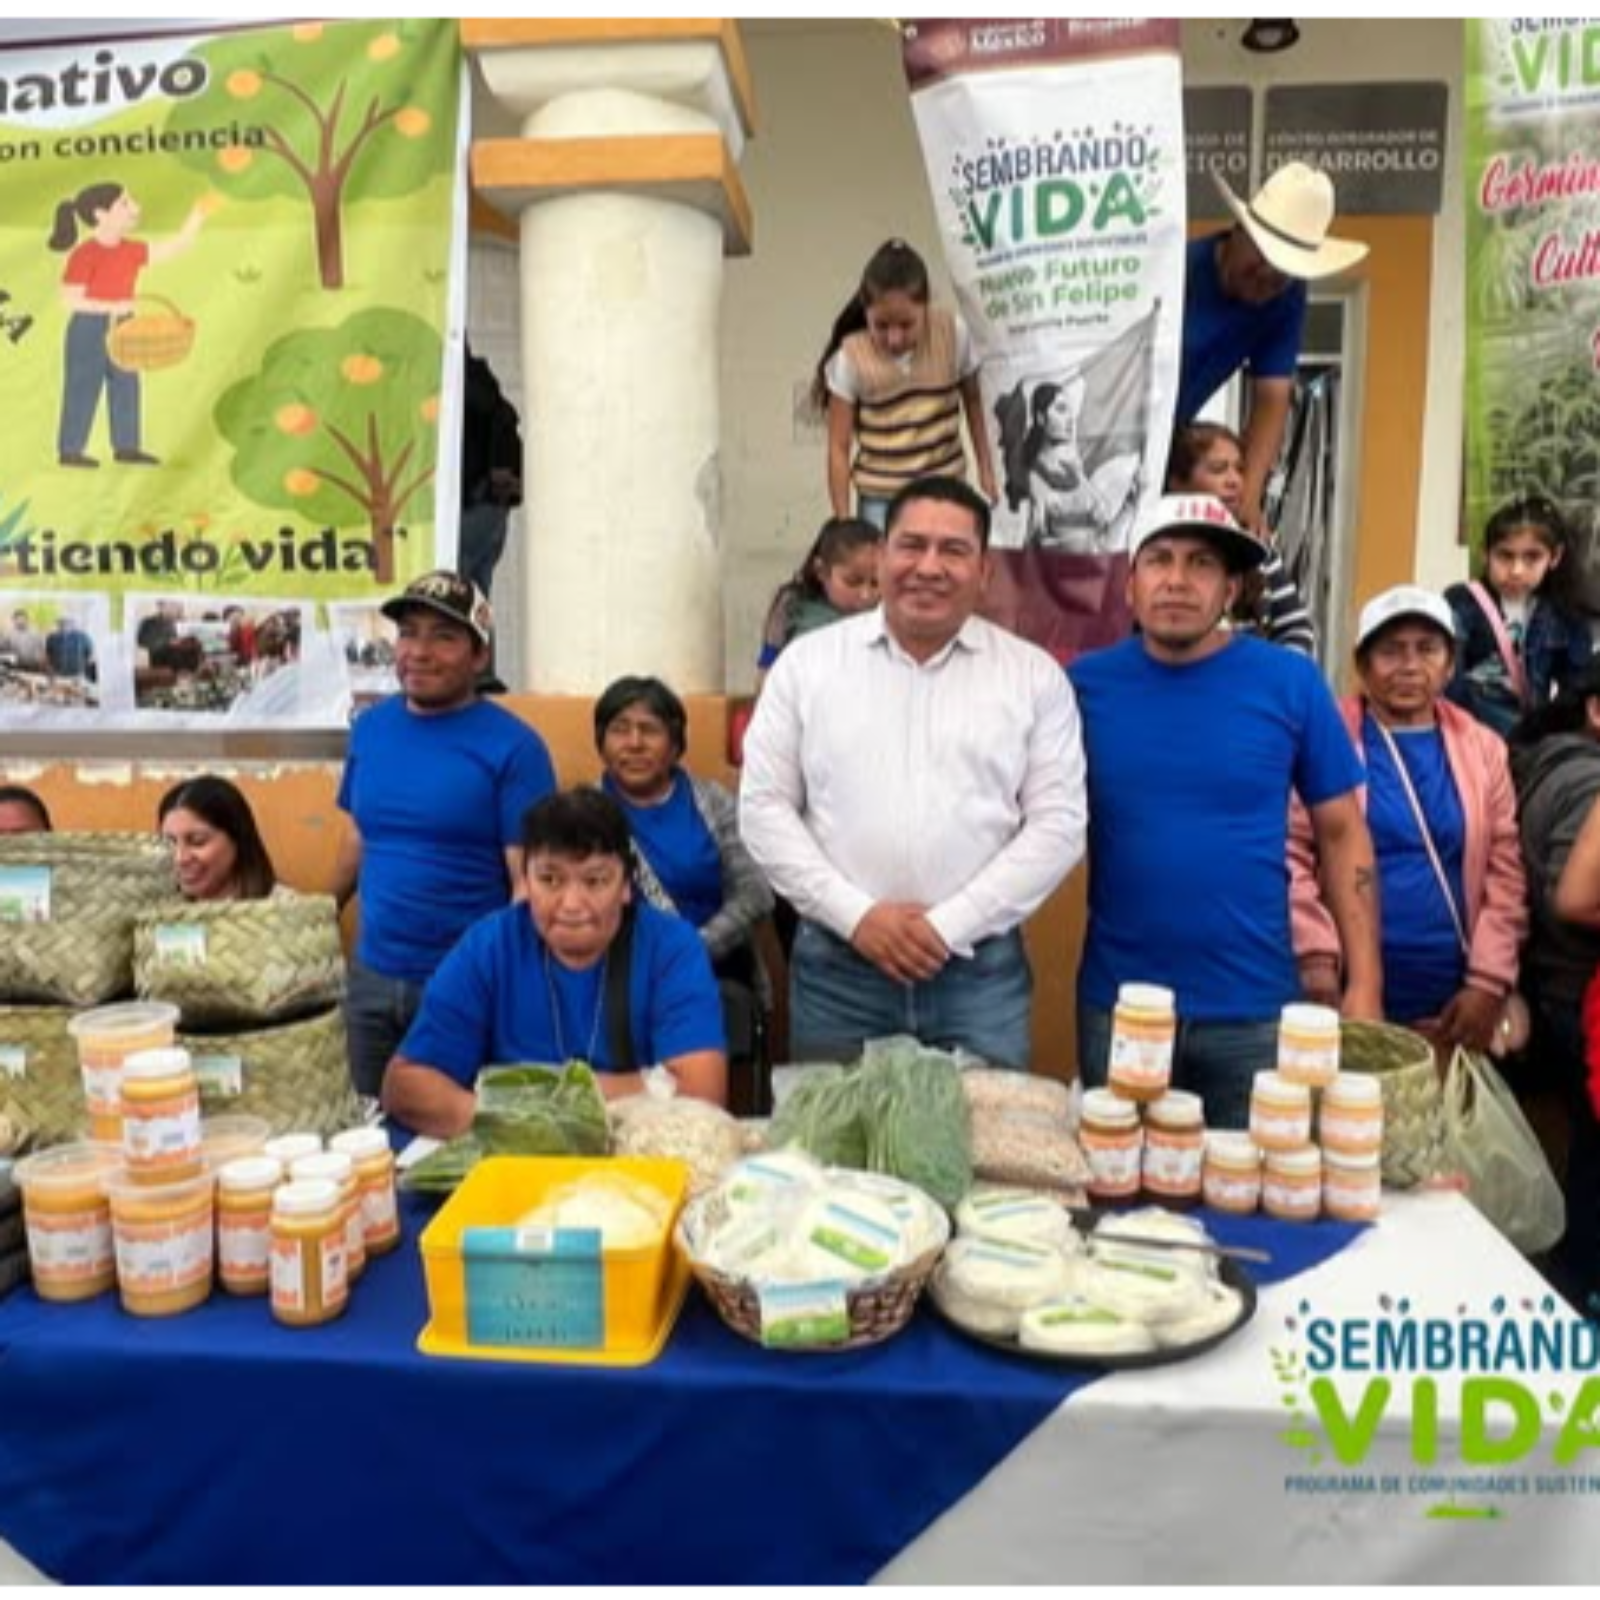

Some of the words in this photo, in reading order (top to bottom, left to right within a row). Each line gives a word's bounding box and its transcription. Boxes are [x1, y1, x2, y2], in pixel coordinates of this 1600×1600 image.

[0, 51, 206, 113] ativo
[54, 122, 267, 157] conciencia
[962, 135, 1147, 195] SEMBRANDO
[968, 171, 1147, 250] VIDA
[1046, 256, 1141, 281] Futuro
[1054, 279, 1139, 307] Felipe
